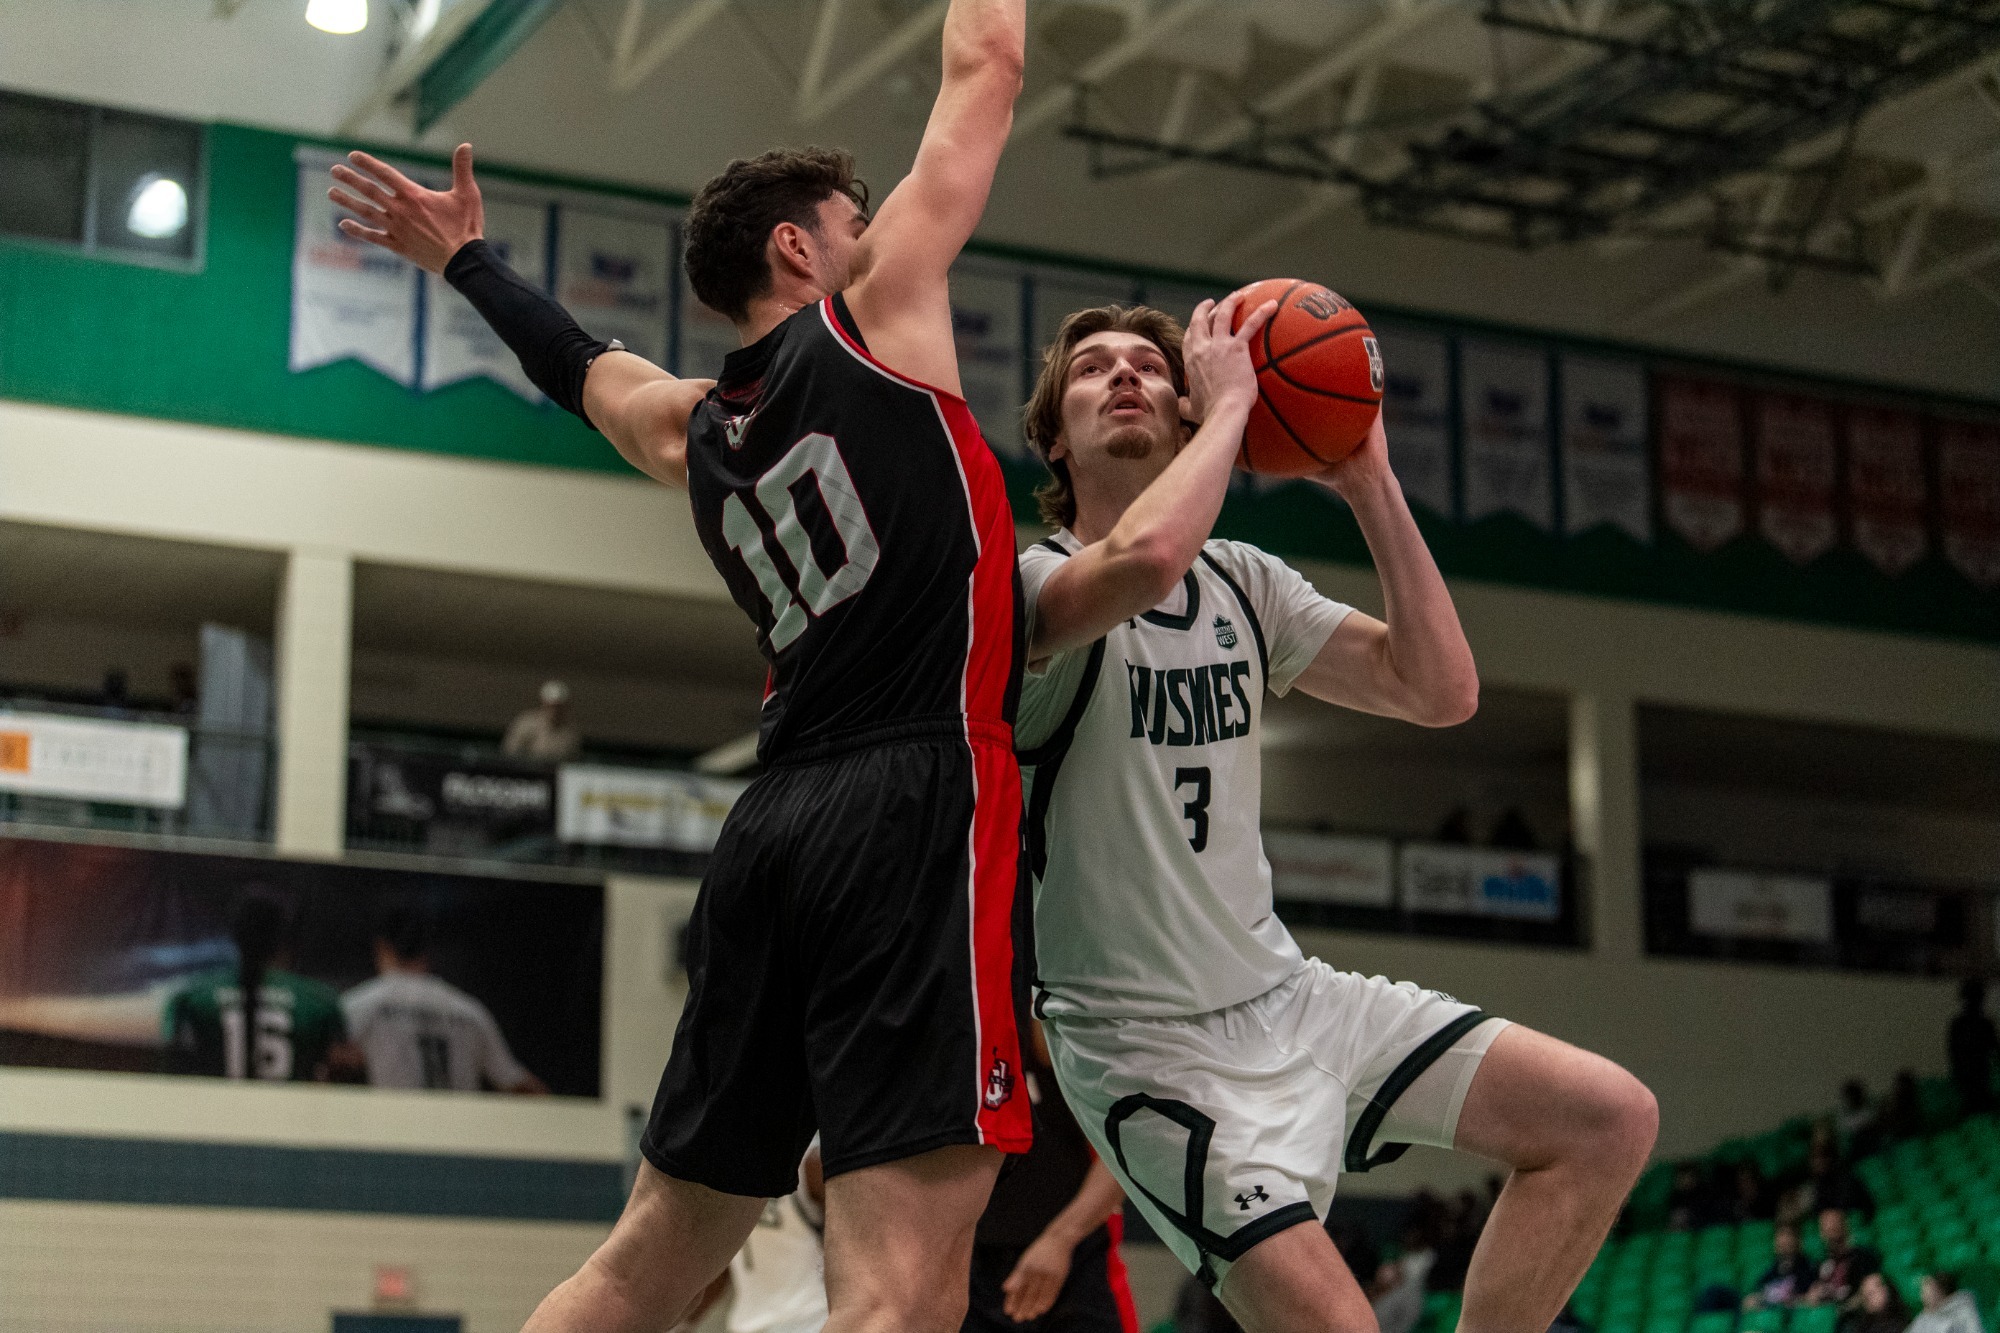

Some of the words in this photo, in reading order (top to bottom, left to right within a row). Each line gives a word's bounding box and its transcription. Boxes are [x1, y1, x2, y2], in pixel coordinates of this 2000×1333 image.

[722, 432, 880, 653] 10
[1217, 633, 1236, 646] WEST
[1174, 766, 1212, 853] 3
